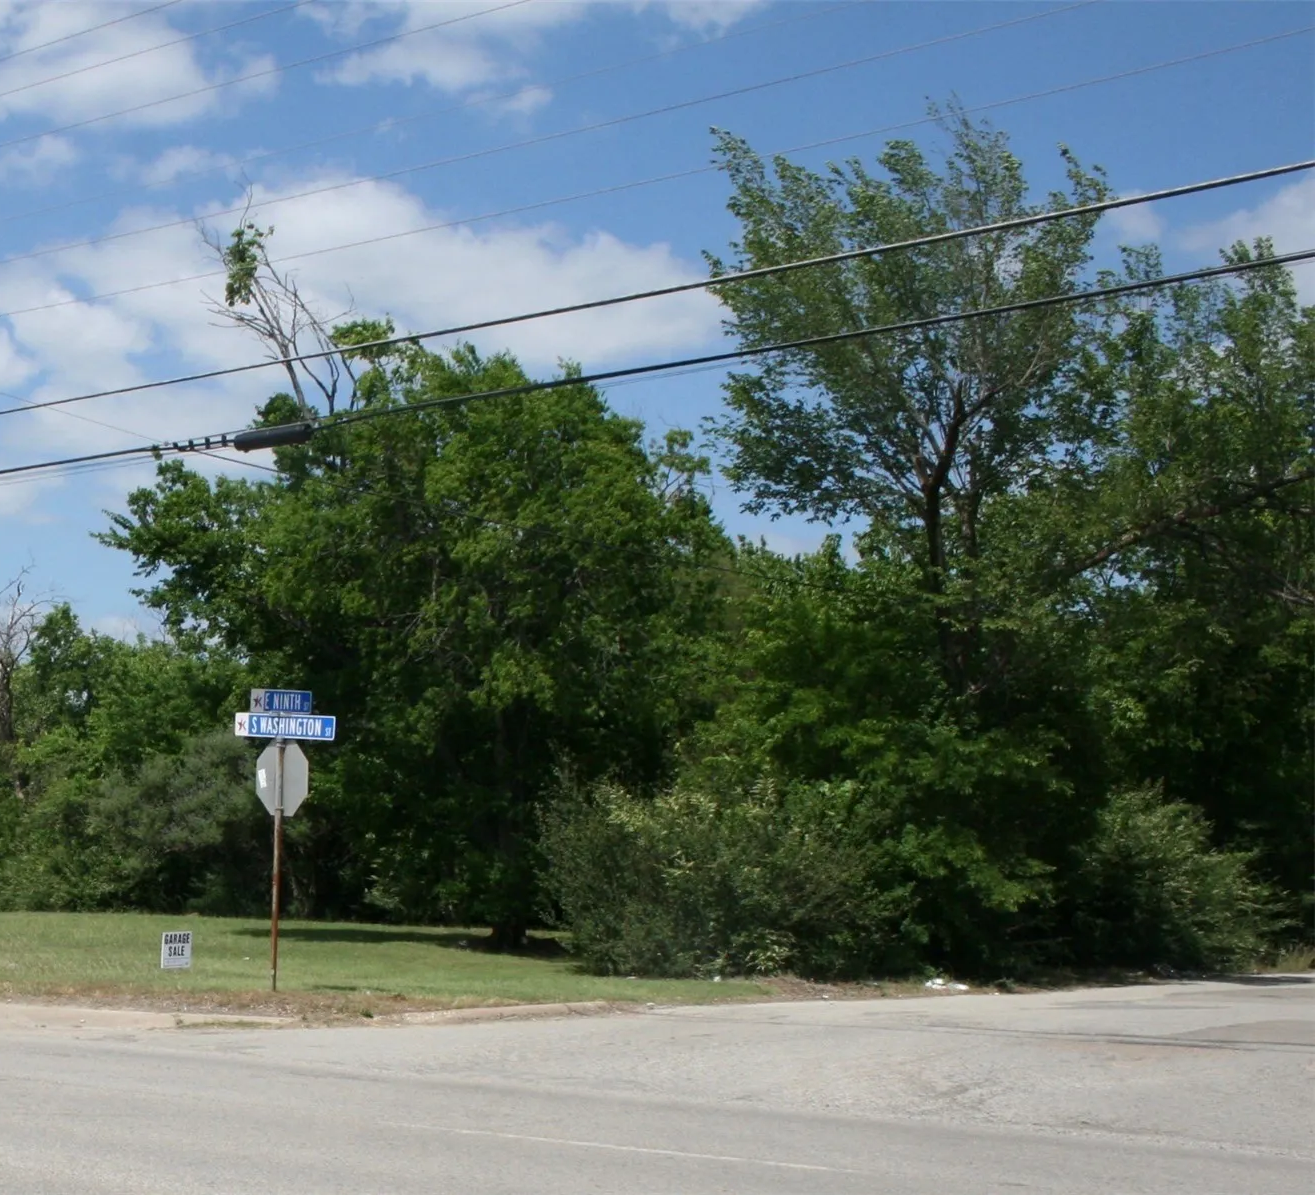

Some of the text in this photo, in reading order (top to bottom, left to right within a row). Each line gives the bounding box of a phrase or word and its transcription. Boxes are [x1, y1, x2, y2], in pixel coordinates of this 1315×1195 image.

[265, 693, 271, 709] E
[273, 693, 301, 710] NINTH
[252, 716, 332, 737] S WASHINGTON ST
[165, 933, 190, 945] GARAGE
[168, 945, 185, 957] SALE
